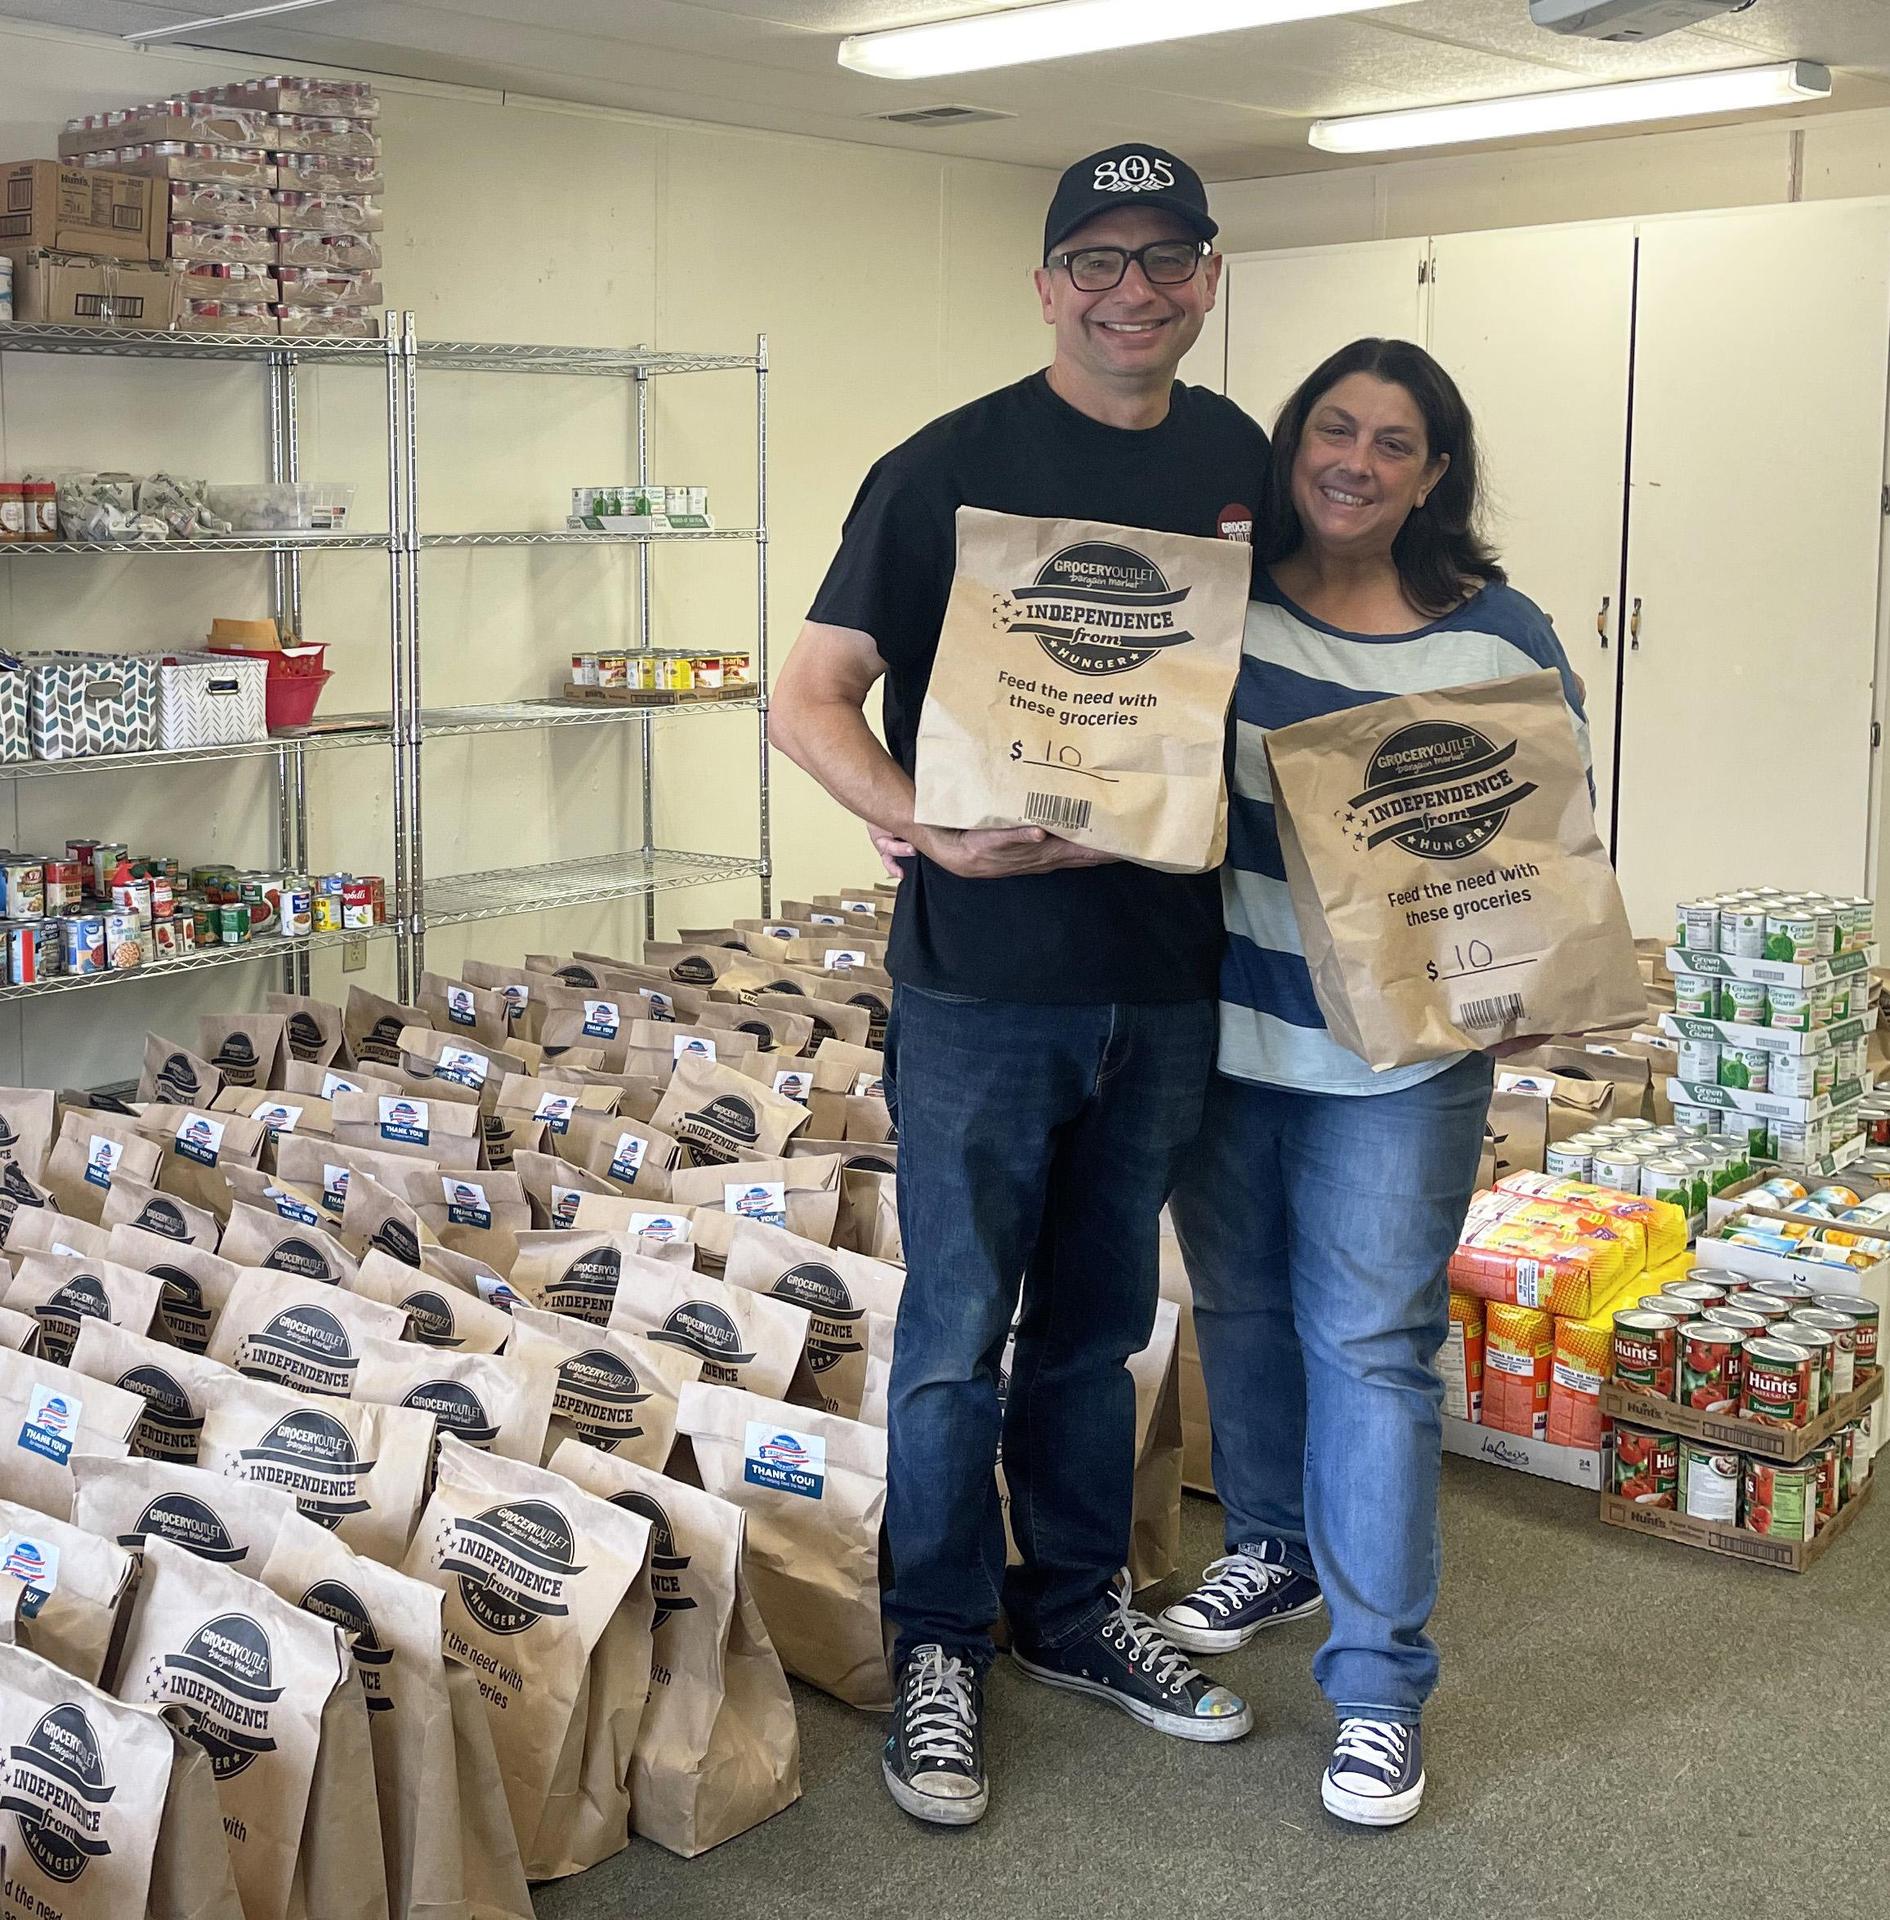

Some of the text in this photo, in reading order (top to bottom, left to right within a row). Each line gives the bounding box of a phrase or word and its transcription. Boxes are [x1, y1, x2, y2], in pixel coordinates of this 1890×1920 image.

[1093, 155, 1175, 191] 805
[1069, 574, 1141, 589] bargain market
[1026, 604, 1174, 630] INDEPENDENCE
[1072, 627, 1122, 646] from
[1057, 647, 1128, 670] HUNGER
[998, 671, 1157, 708] Feed the need with
[1009, 694, 1138, 726] these groceries
[1046, 740, 1082, 767] 10
[1368, 769, 1513, 824] INDEPENDENCE
[1420, 808, 1471, 833] from
[1419, 827, 1485, 852] HUNGER
[1387, 862, 1540, 908] Feed the need with
[1406, 887, 1532, 927] these groceries
[1455, 940, 1493, 970] 10
[1691, 954, 1720, 966] Green
[1694, 963, 1720, 973] Giant
[1732, 984, 1760, 993] Green
[1769, 989, 1796, 999] Green
[1686, 1022, 1714, 1032] Green
[1689, 1030, 1714, 1039] Giant
[1694, 1085, 1723, 1097] Green
[1697, 1094, 1723, 1105] Giant
[385, 1126, 407, 1135] THANK
[687, 1123, 740, 1154] INDEPENDE
[328, 1195, 344, 1206] THA
[452, 1207, 473, 1219] THANK
[551, 1295, 613, 1313] INDEPEN
[252, 1348, 349, 1388] INDEPENDENCE
[553, 1392, 633, 1424] DEPENDENCE
[26, 1428, 51, 1446] THANK
[139, 1423, 197, 1449] ENDENCE
[250, 1465, 356, 1497] INDEPENDENCE
[752, 1464, 787, 1481] THANK
[790, 1473, 815, 1488] YOU!
[459, 1536, 562, 1597] INDEPENDENCE
[483, 1573, 520, 1603] from
[471, 1596, 516, 1627] HUNGER
[449, 1634, 523, 1692] the need with
[477, 1681, 508, 1709] eries
[197, 1711, 230, 1741] from
[13, 1768, 101, 1832] INDEPENDENCE
[40, 1808, 76, 1840] from
[30, 1837, 76, 1872] HUNGER
[16, 1885, 34, 1911] the
